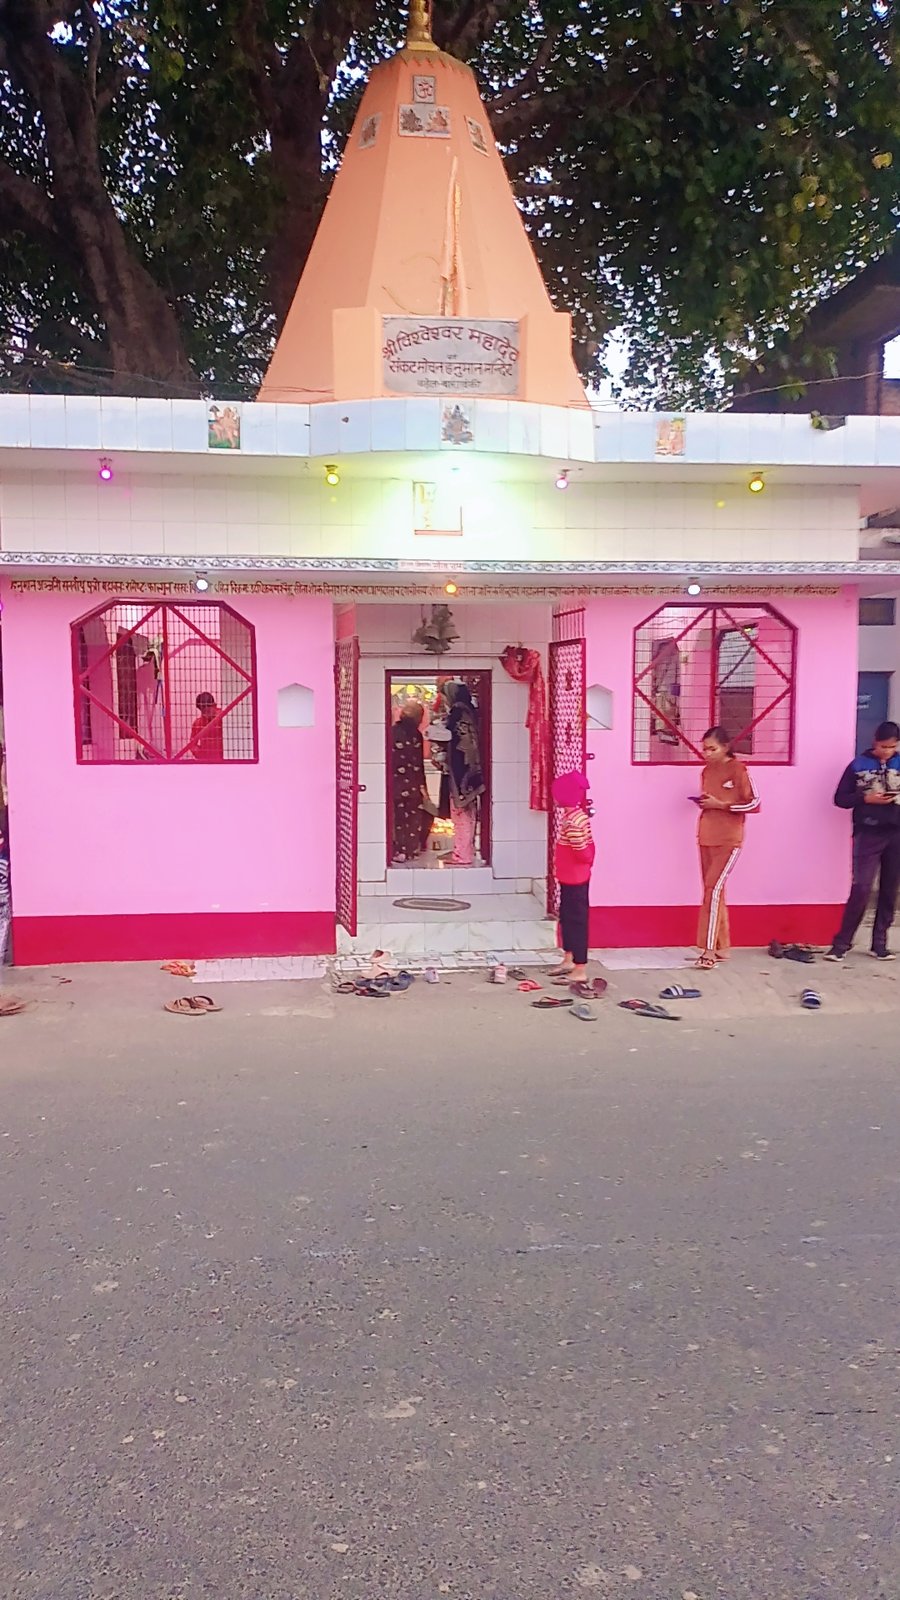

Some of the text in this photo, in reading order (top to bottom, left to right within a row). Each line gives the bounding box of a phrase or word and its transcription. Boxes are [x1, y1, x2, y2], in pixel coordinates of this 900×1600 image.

[468, 328, 520, 362] महादेव
[444, 361, 482, 377] हनुमान
[483, 357, 513, 376] मन्दिर
